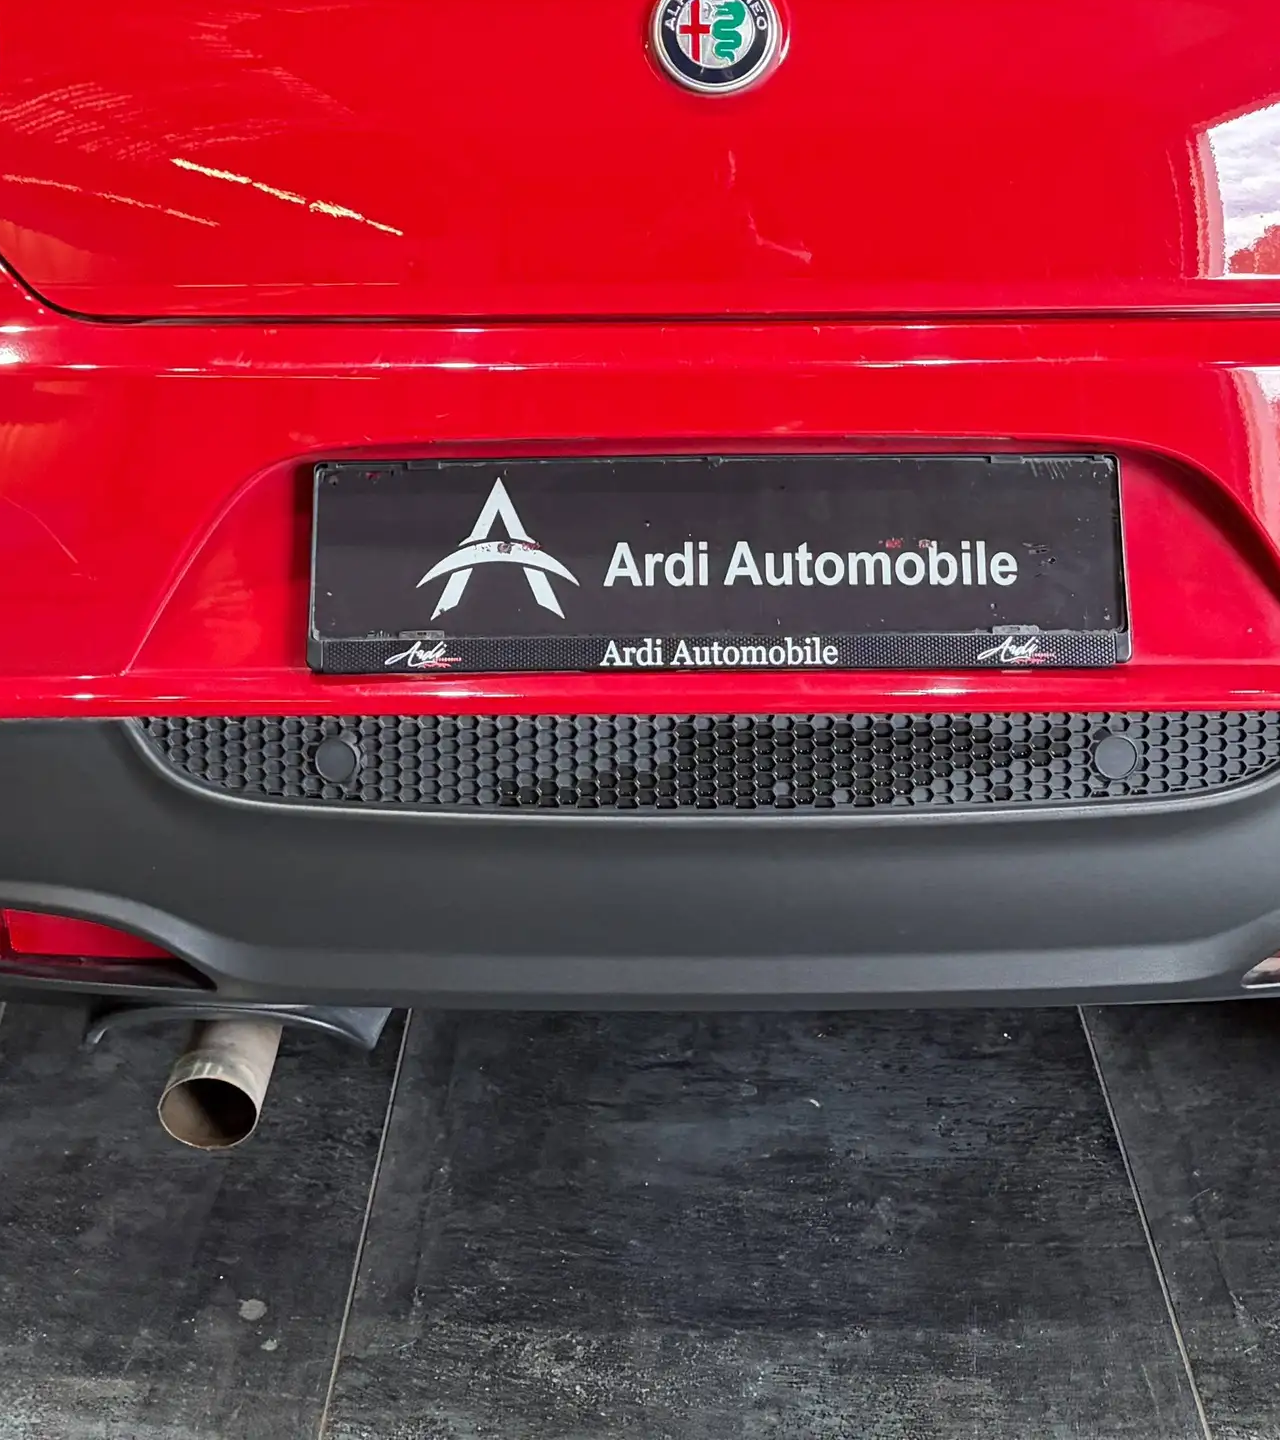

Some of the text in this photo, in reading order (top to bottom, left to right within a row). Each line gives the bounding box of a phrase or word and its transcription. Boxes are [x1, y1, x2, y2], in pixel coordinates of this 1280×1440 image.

[603, 541, 1019, 587] Ardi Automobile
[600, 637, 839, 666] Ardi Automobile
